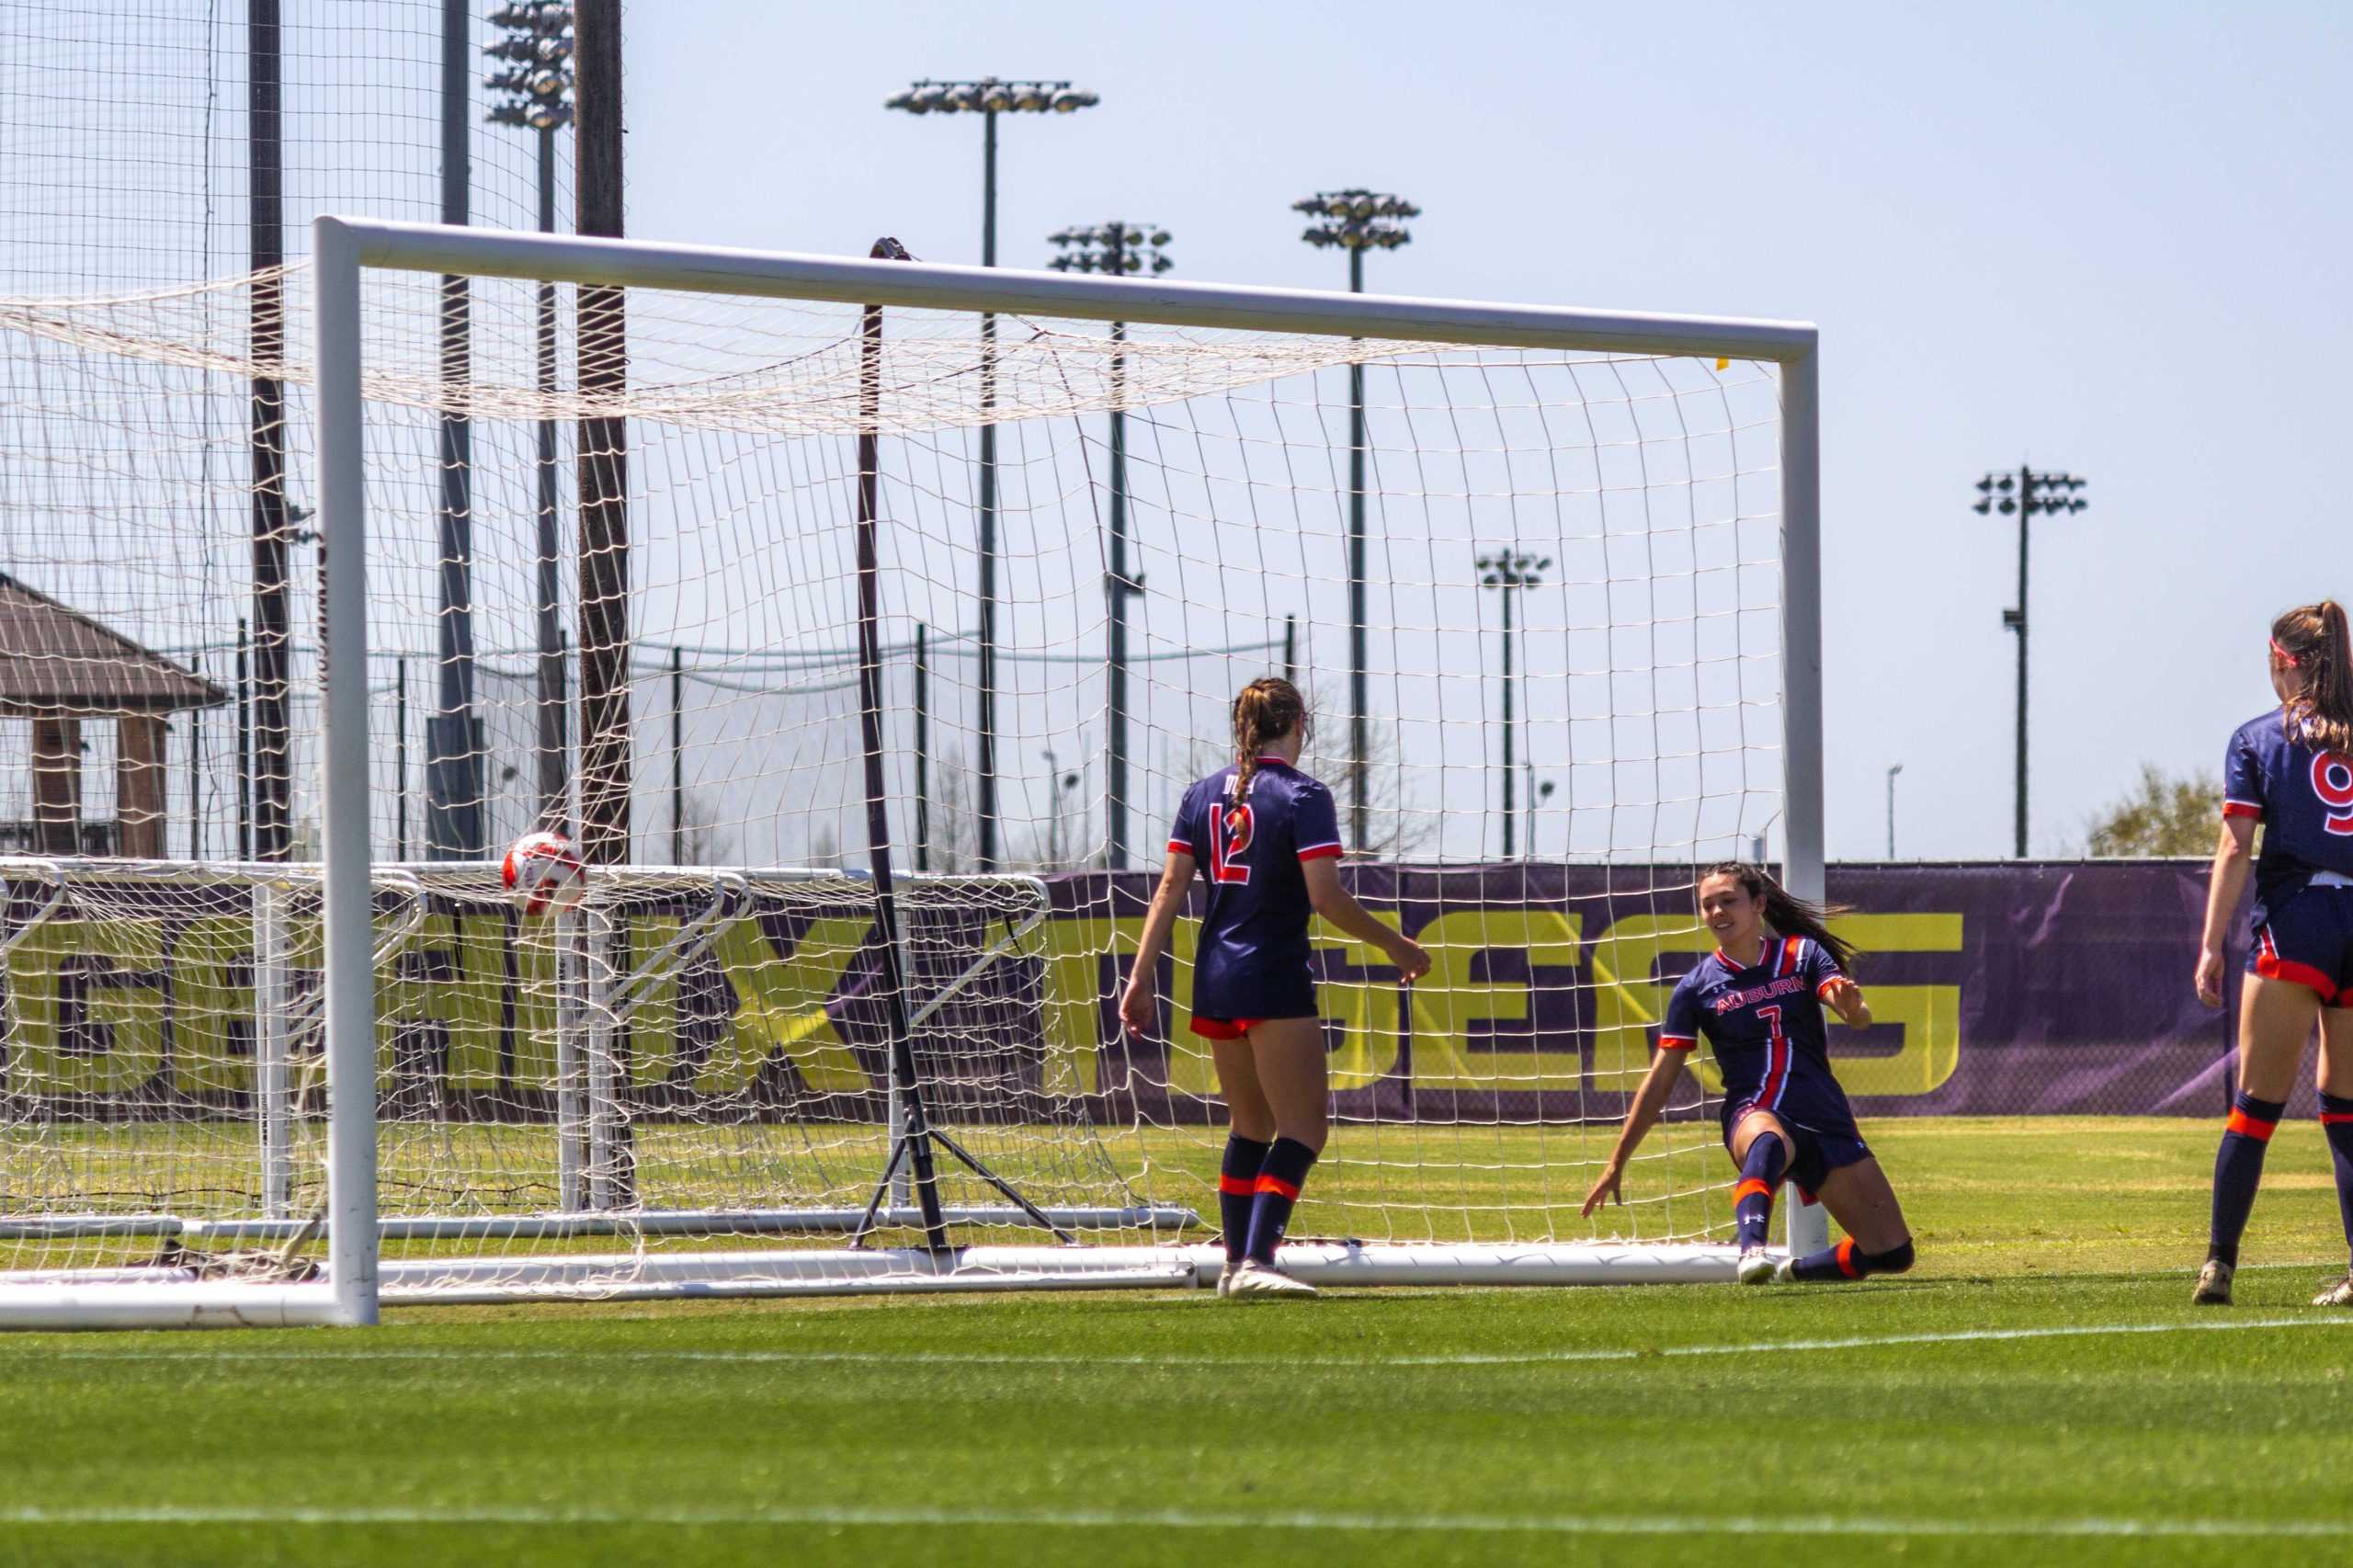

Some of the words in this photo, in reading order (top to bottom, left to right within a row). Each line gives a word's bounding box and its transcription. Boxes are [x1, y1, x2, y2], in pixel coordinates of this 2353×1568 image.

[2310, 750, 2353, 835] 9
[1209, 802, 1256, 886] 12
[1716, 975, 1807, 1016] AUBURN
[1756, 1005, 1782, 1040] 7
